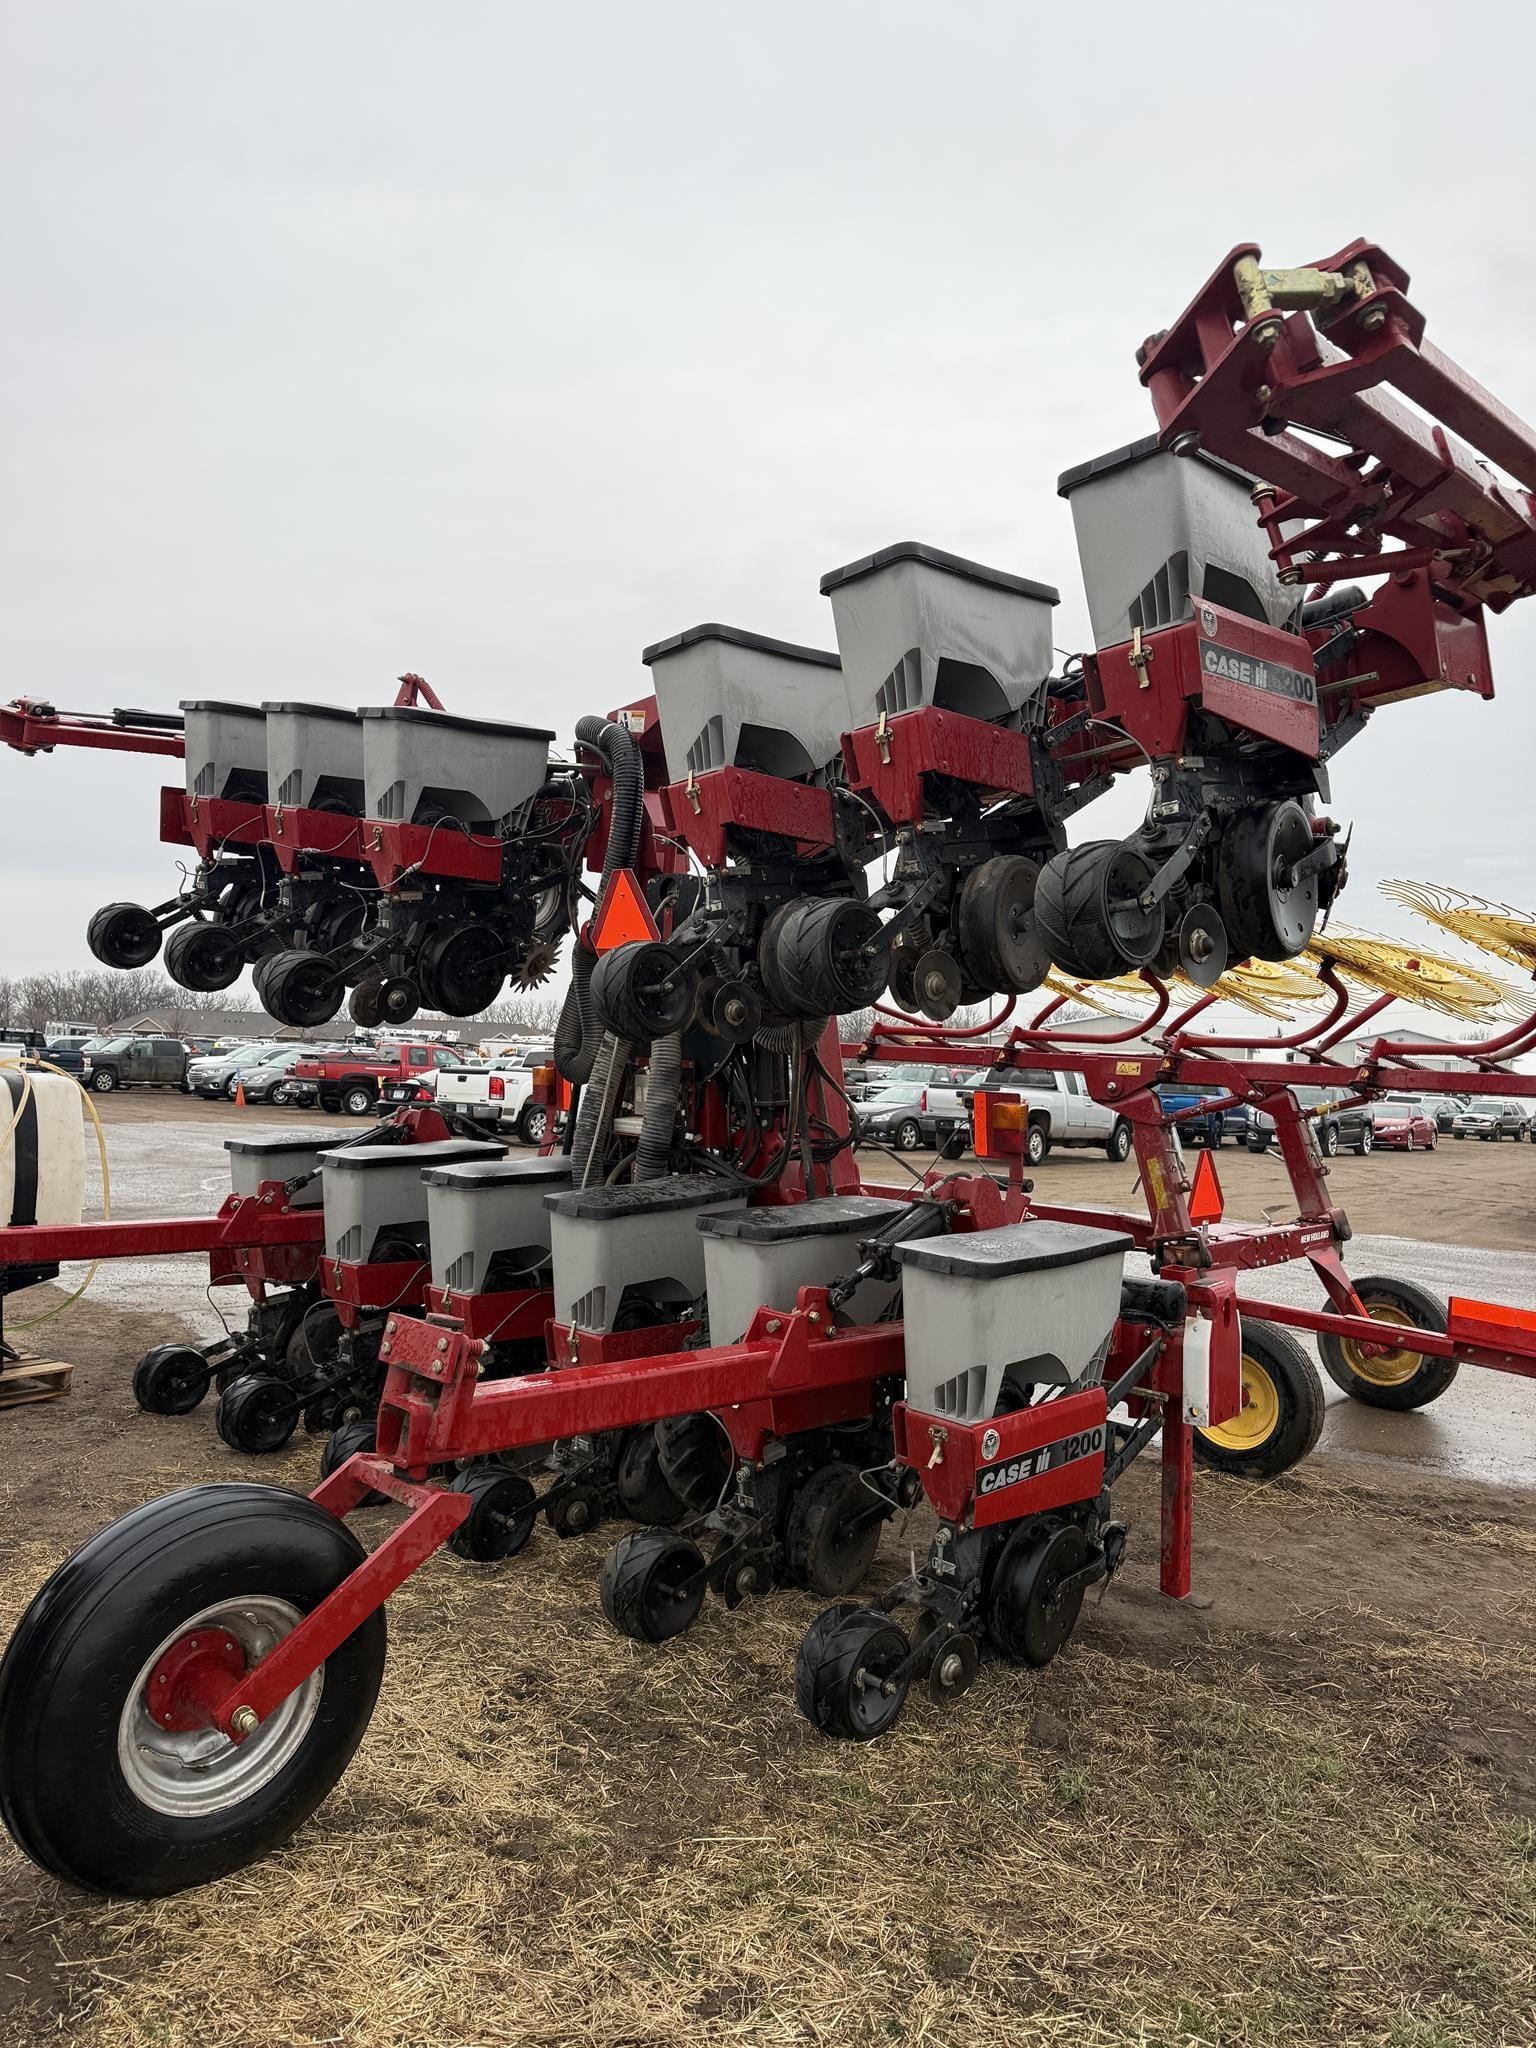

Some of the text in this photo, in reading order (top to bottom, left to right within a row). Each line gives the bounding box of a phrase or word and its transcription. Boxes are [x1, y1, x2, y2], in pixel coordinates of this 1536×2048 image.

[1205, 650, 1251, 683] CASE
[981, 1458, 1033, 1493] CASE
[1062, 1428, 1101, 1462] 1200
